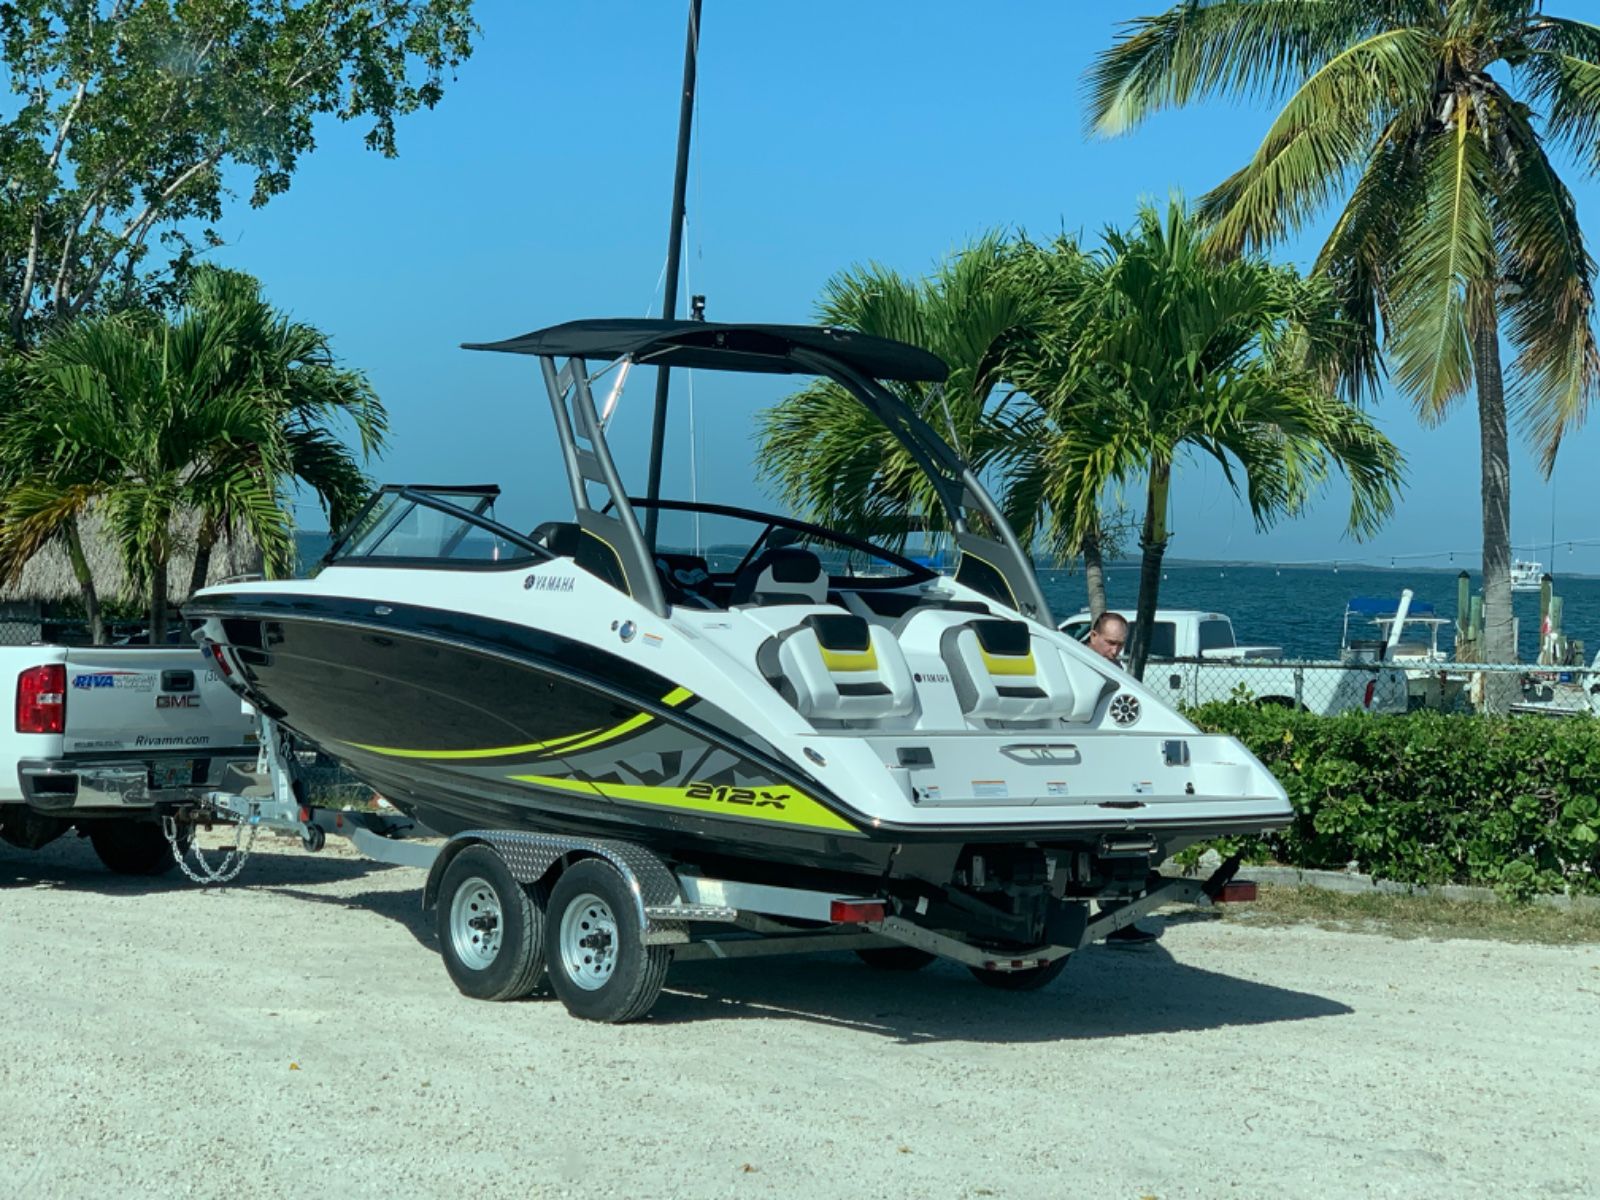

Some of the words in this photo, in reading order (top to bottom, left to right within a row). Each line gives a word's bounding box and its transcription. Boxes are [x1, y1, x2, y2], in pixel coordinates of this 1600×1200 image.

[536, 575, 576, 592] YAMAHA
[74, 675, 114, 687] RIVA
[155, 695, 201, 708] GMC
[135, 735, 210, 746] Rivamm.com
[685, 783, 791, 810] 212X
